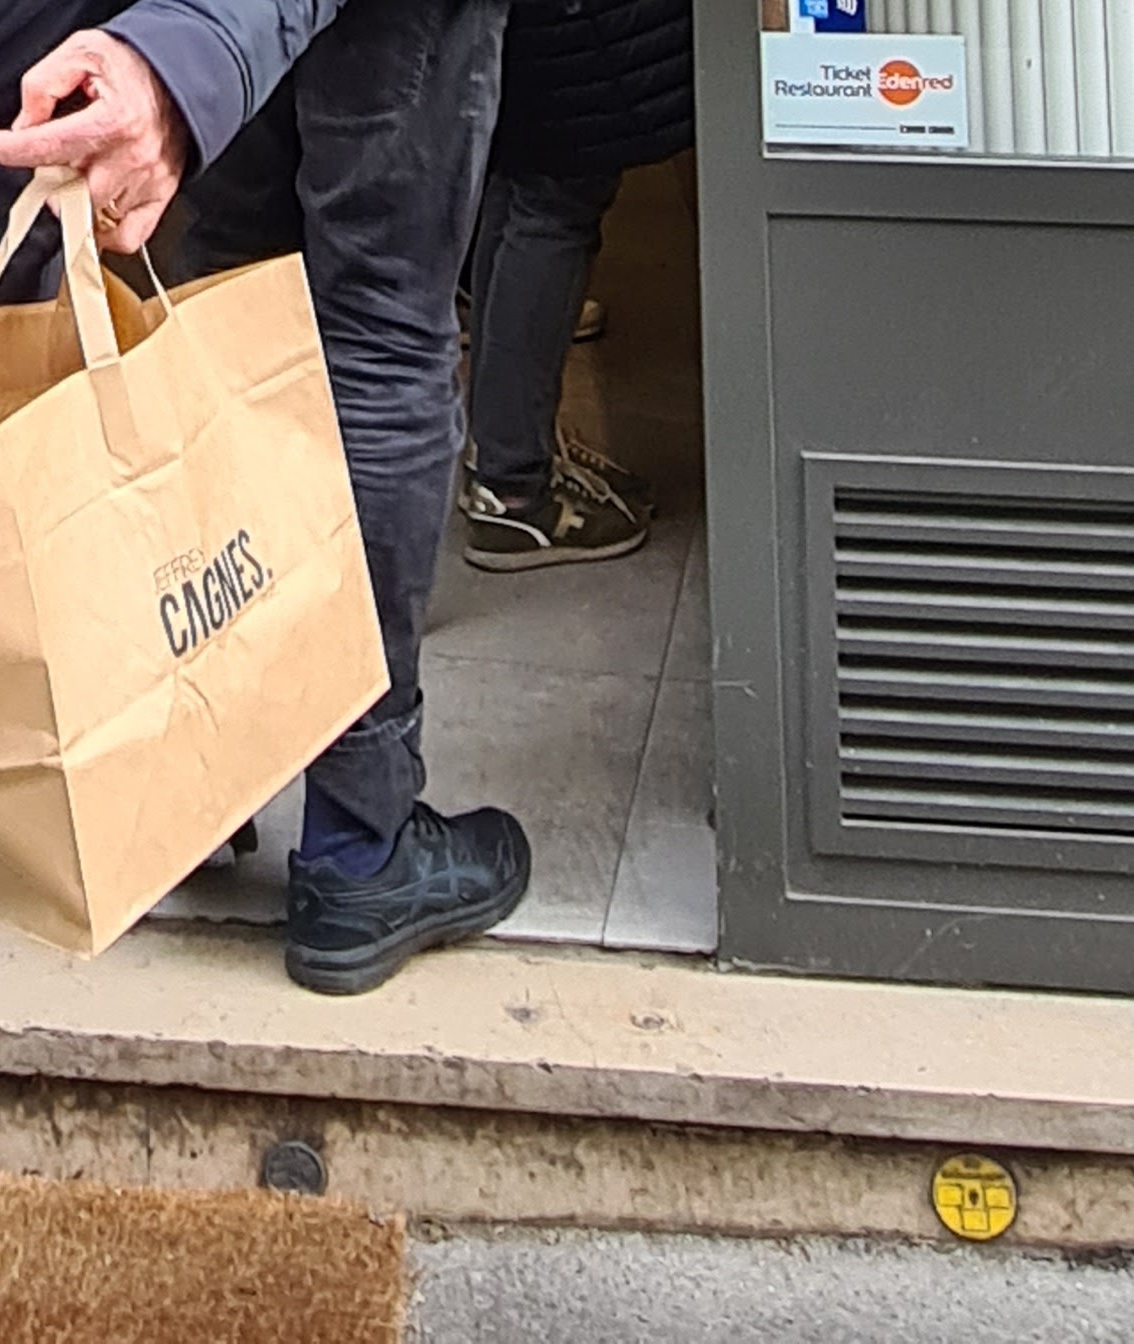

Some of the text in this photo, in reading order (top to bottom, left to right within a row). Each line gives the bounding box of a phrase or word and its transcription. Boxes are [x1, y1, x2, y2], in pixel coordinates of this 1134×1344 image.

[820, 64, 872, 82] Ticket
[878, 71, 954, 91] Edenred
[774, 79, 873, 98] Restaurant
[160, 528, 274, 658] CAGNES.
